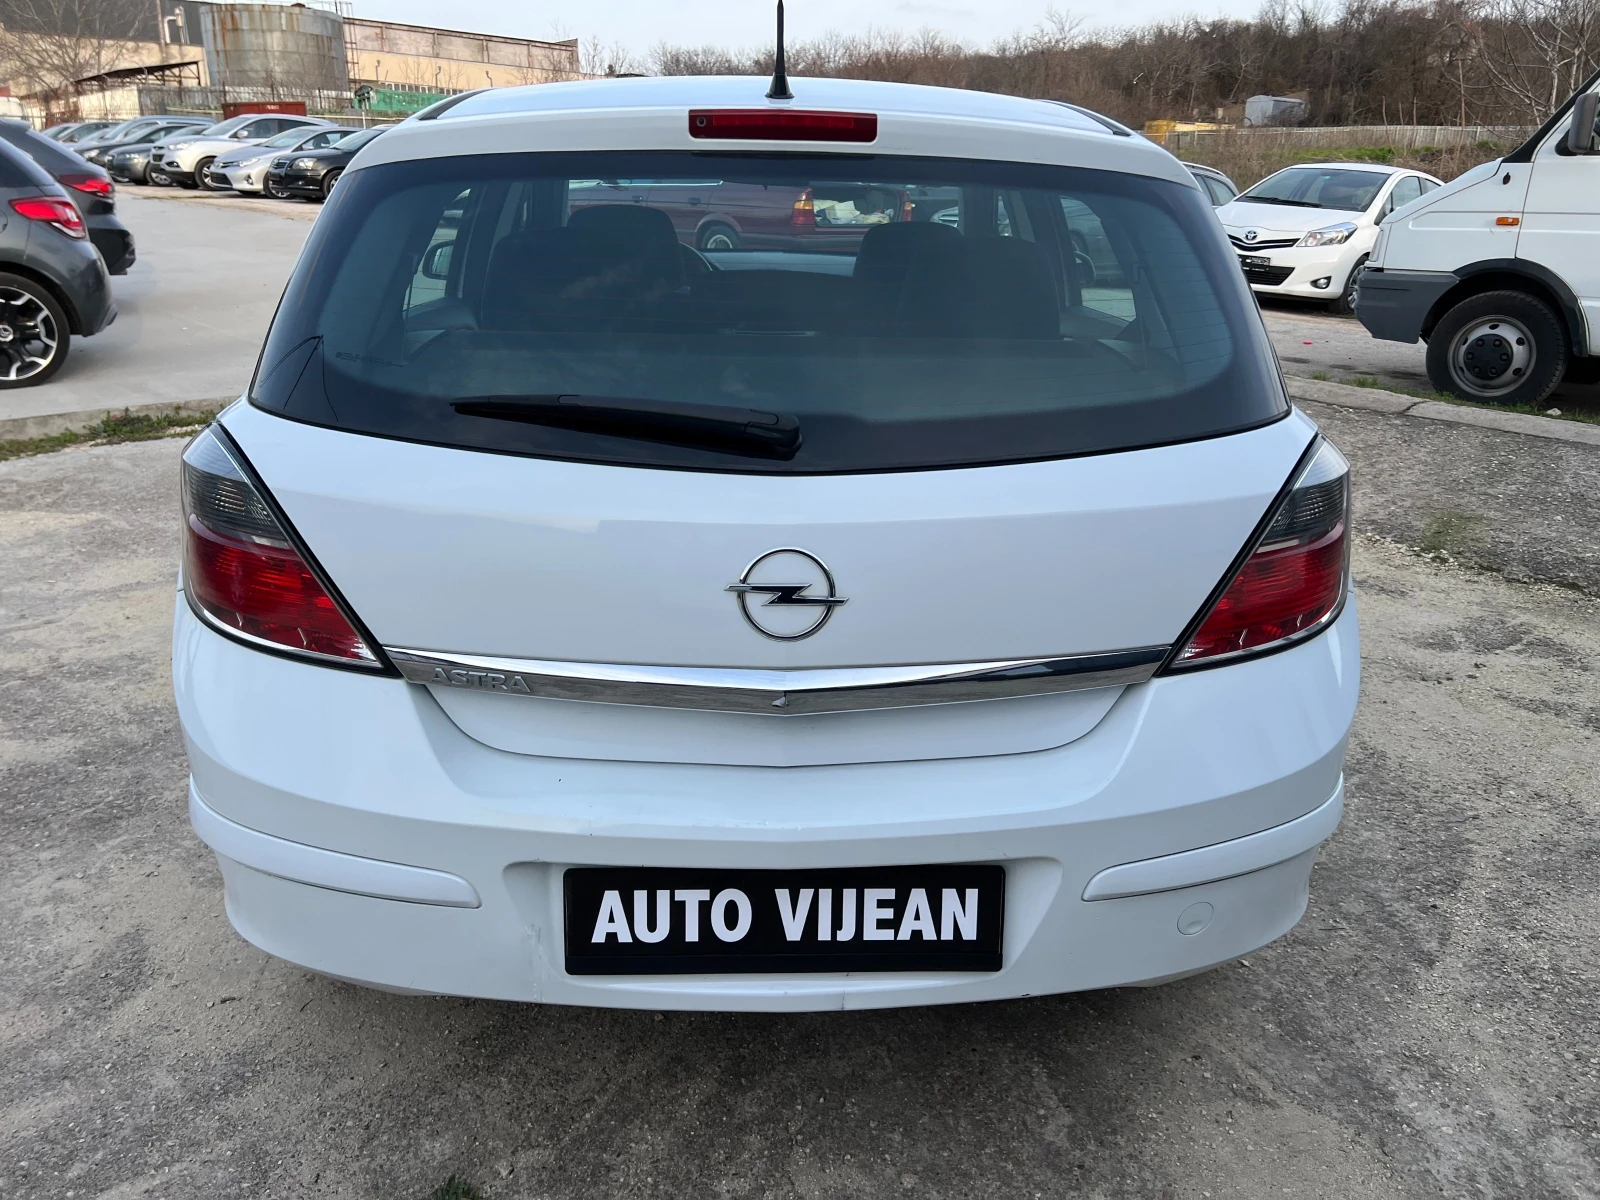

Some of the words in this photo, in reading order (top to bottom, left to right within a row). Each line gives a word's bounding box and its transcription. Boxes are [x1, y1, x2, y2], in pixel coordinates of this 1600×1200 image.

[432, 668, 531, 693] ASTRA
[591, 889, 752, 943] AUTO
[775, 888, 979, 942] VIJEAN
